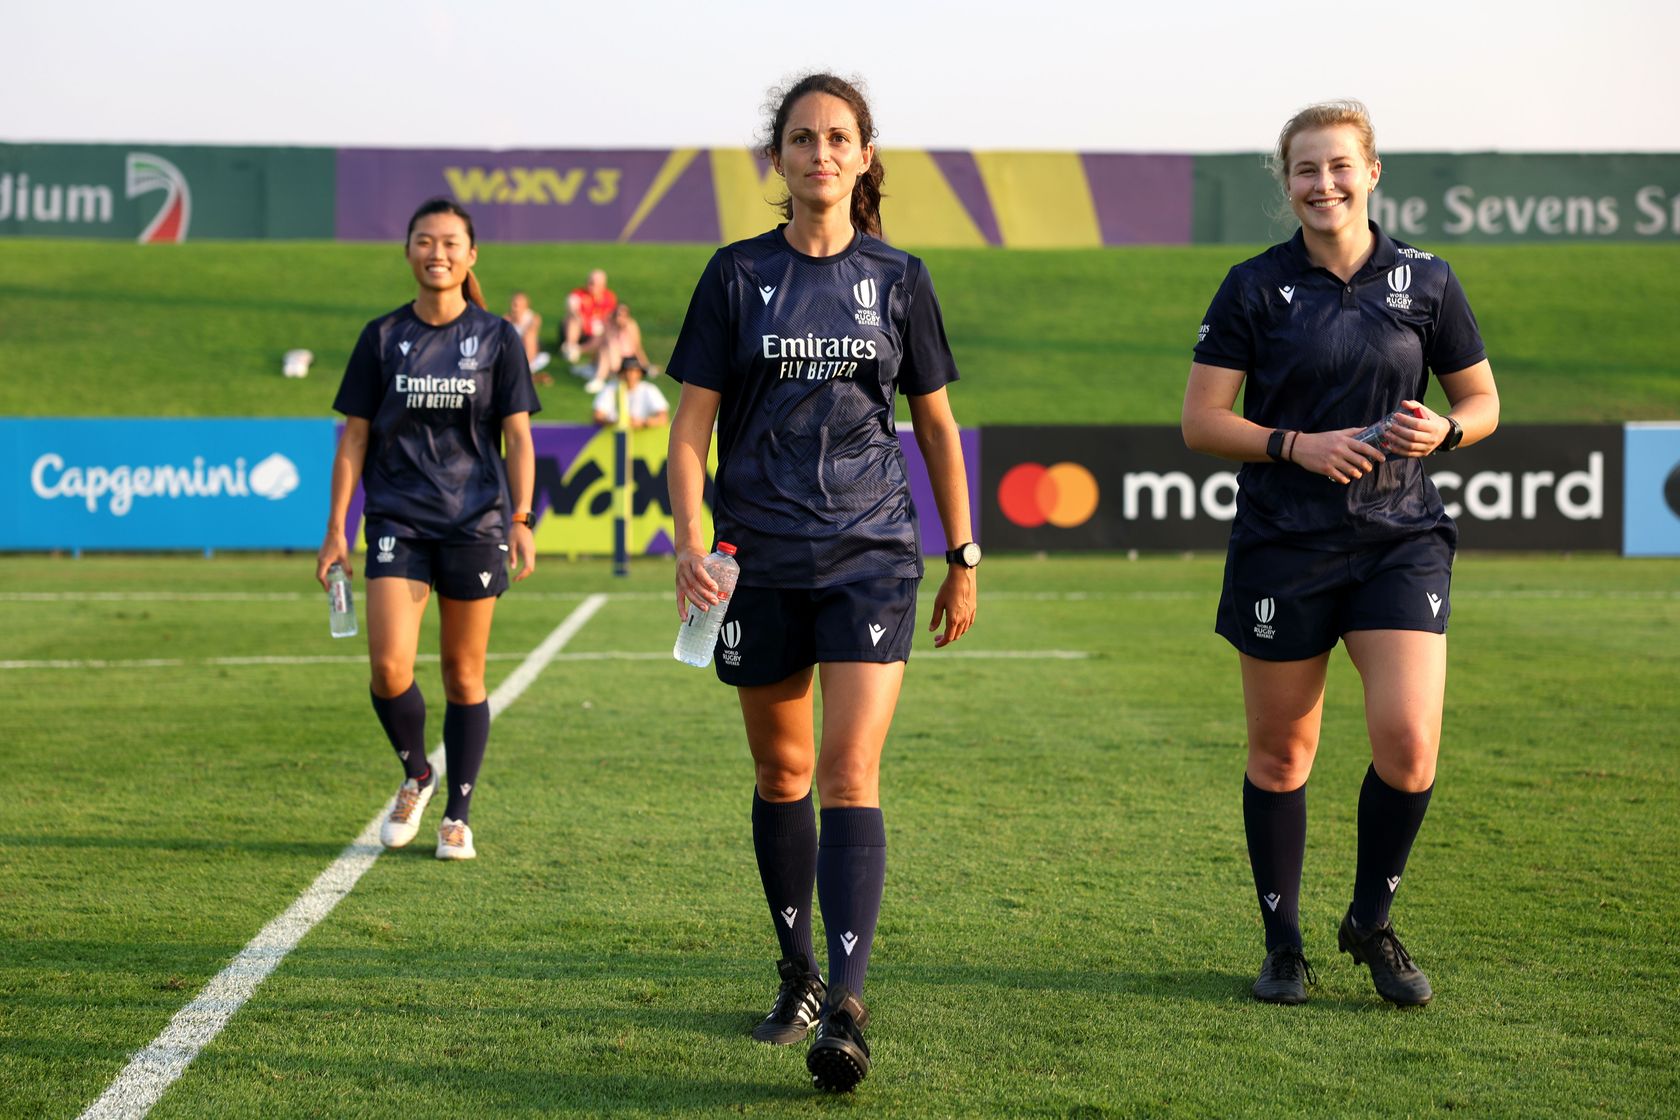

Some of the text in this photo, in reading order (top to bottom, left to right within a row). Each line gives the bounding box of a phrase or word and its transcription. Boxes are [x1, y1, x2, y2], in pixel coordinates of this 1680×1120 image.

[588, 168, 622, 204] 3
[1443, 185, 1619, 235] Sevens
[1386, 297, 1413, 306] RUGBY
[854, 313, 880, 323] RUGBY
[762, 332, 877, 360] Emirates
[779, 361, 858, 380] FLY BETTER
[395, 374, 477, 394] Emirates
[406, 393, 465, 409] FLY BETTER
[31, 453, 249, 516] Capgemini
[1253, 626, 1276, 636] RUGBY
[722, 653, 742, 662] RUGBY
